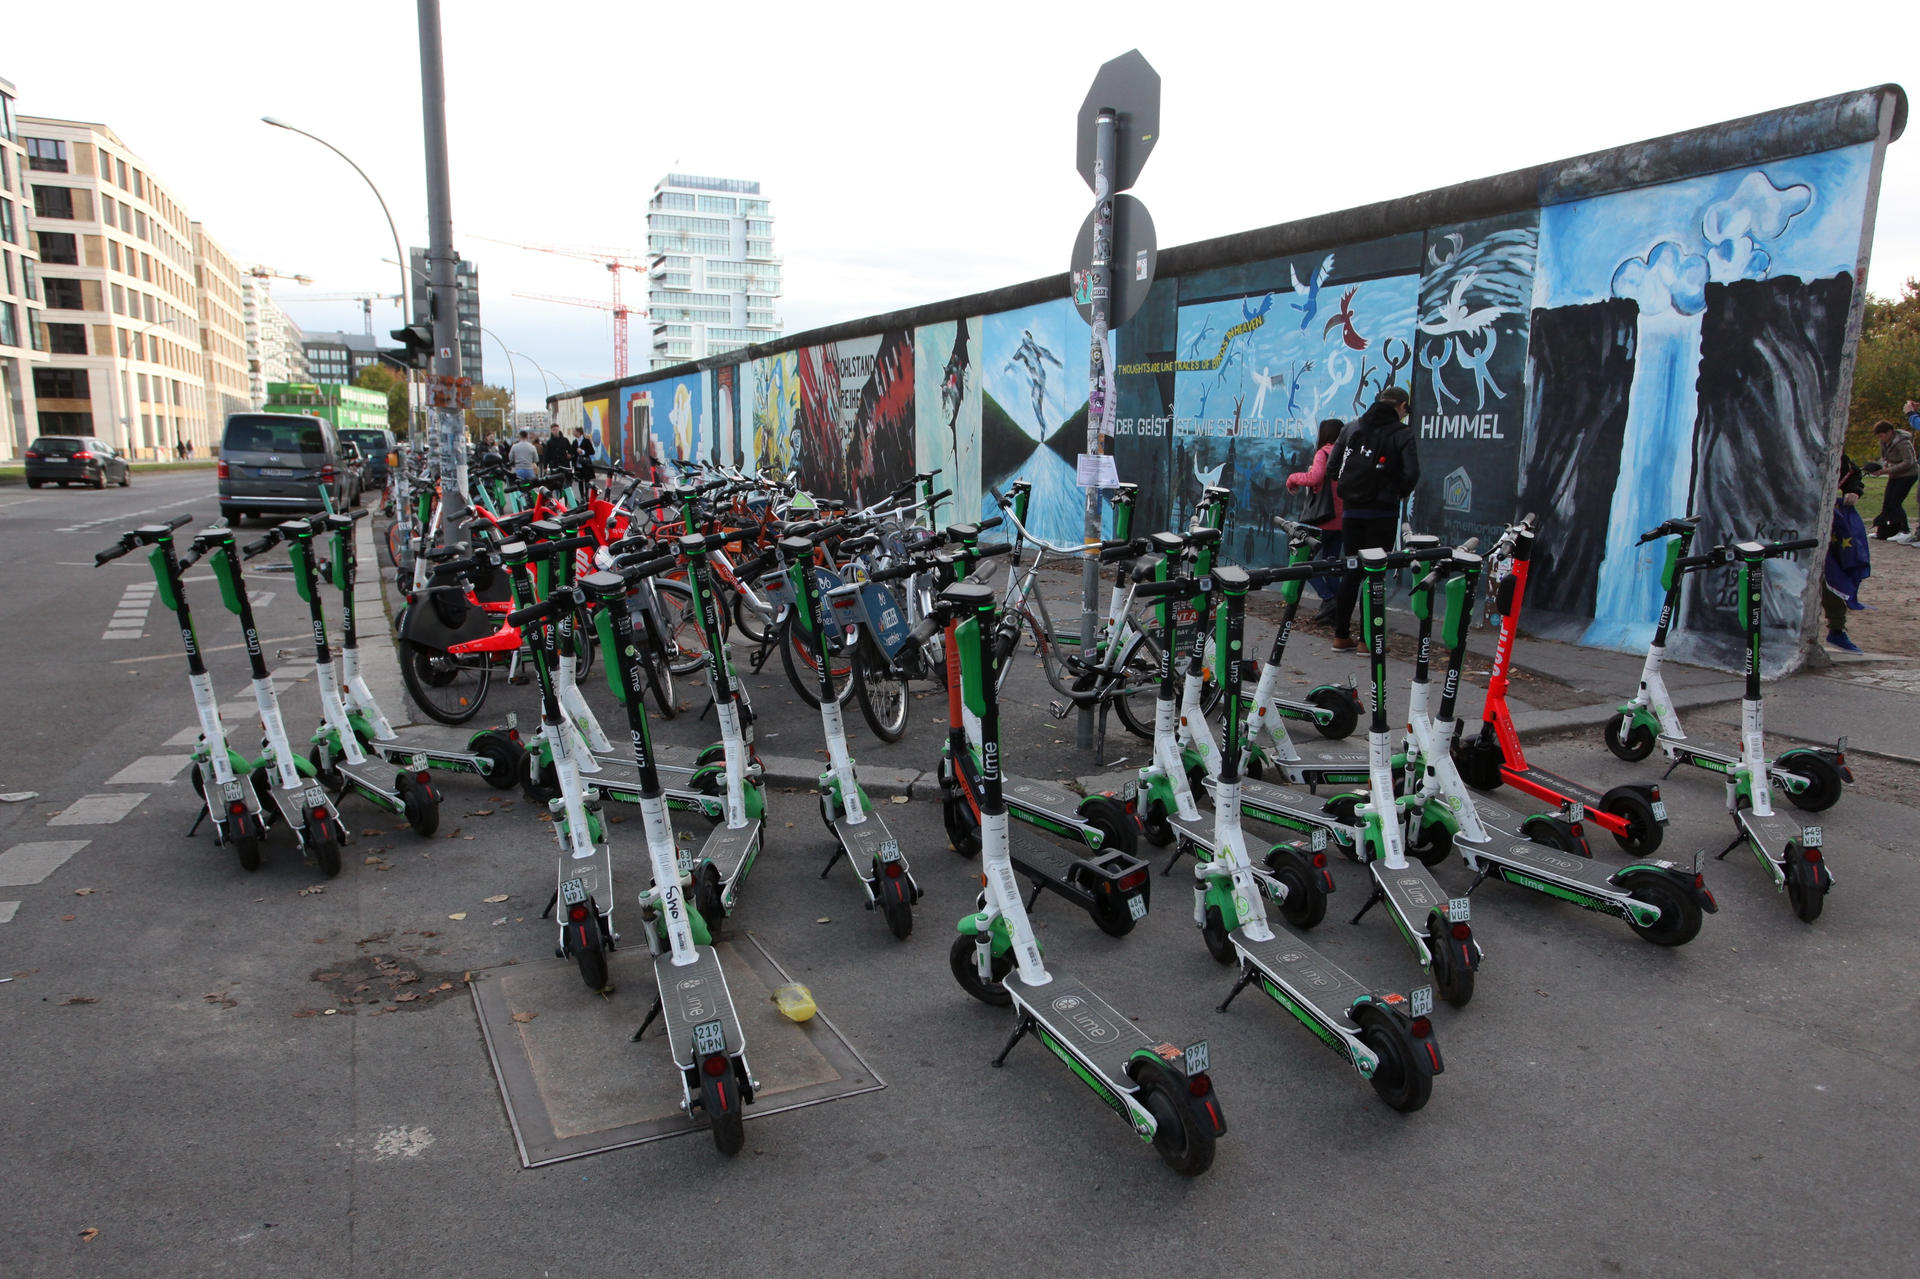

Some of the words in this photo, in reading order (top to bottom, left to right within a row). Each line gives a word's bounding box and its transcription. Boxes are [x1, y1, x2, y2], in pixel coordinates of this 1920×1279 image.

[1118, 363, 1150, 375] THOUGHTS
[1151, 362, 1161, 373] ARE
[1175, 361, 1200, 370] TRACES
[1202, 360, 1210, 369] OF
[1234, 315, 1264, 336] HEAVEN
[1116, 418, 1133, 435] DER
[1174, 418, 1191, 437] IST
[1193, 418, 1215, 437] WIE
[1274, 418, 1304, 439] DER
[1420, 414, 1504, 439] HIMMEL
[705, 606, 714, 625] Lime
[1659, 605, 1670, 628] Lime
[183, 629, 195, 655] Lime
[247, 628, 260, 655] Lime
[313, 620, 325, 645] Lime
[547, 624, 555, 650] Lime
[1278, 621, 1292, 646] Lime
[1193, 632, 1205, 657] Lime
[1419, 637, 1431, 663] Lime
[1161, 650, 1169, 678] Lime
[1230, 661, 1240, 684] Lime
[632, 664, 641, 692] Lime
[1443, 669, 1458, 698] Lime
[631, 730, 646, 768] Lime
[985, 742, 998, 780] Lime
[1705, 761, 1724, 771] Lime
[308, 788, 322, 798] 426
[1018, 810, 1034, 823] Lime
[1253, 809, 1271, 821] Lime
[882, 841, 897, 851] 795
[884, 849, 898, 861] WPL
[1520, 876, 1544, 891] Lime
[1451, 900, 1468, 910] 385
[1452, 910, 1469, 920] WUG
[1275, 989, 1292, 1010] Lime
[1413, 989, 1431, 1003] 927
[1414, 1002, 1431, 1015] WPL
[698, 1023, 719, 1039] 219
[1073, 1011, 1106, 1038] Lime
[699, 1038, 722, 1053] WPN
[1187, 1044, 1206, 1059] 997
[1188, 1058, 1208, 1074] WPK
